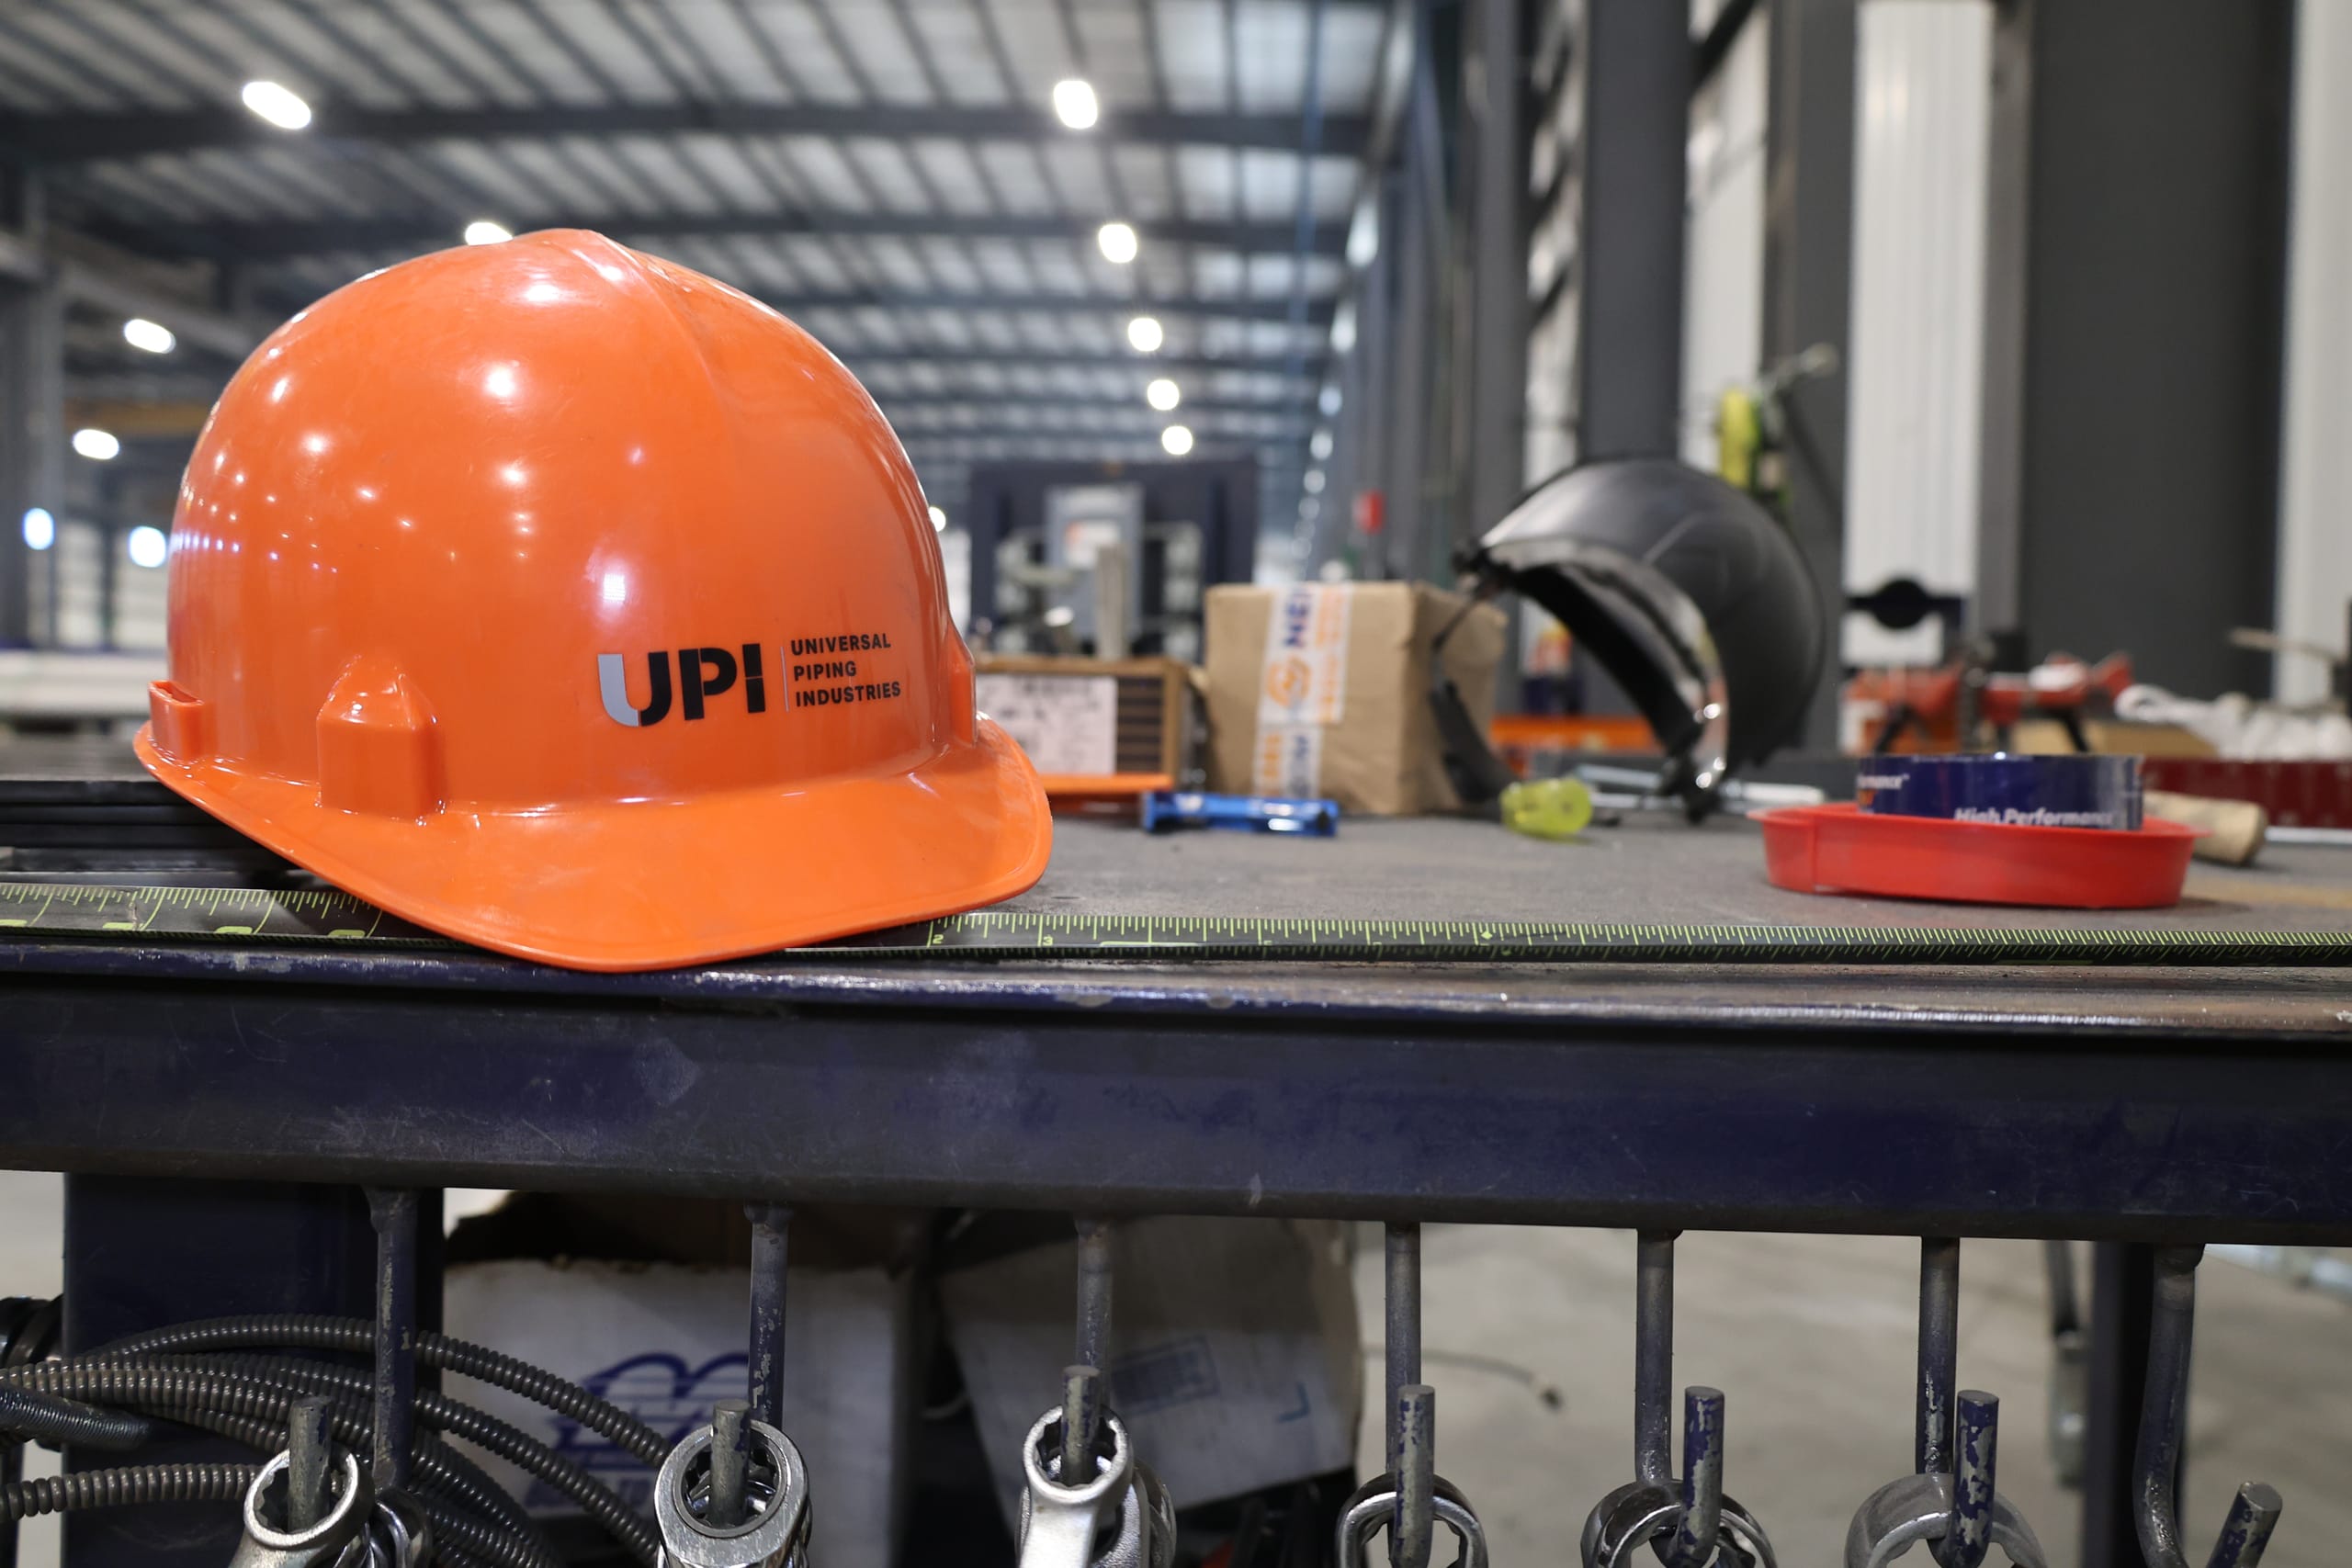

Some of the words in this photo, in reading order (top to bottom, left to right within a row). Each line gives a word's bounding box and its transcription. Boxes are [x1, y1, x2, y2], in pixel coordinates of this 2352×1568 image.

[791, 633, 891, 656] UNIVERSAL
[793, 660, 857, 682] PIPING
[597, 643, 765, 727] UPI
[796, 682, 901, 707] INDUSTRIES
[932, 933, 944, 944] 2
[1042, 934, 1054, 946] 3
